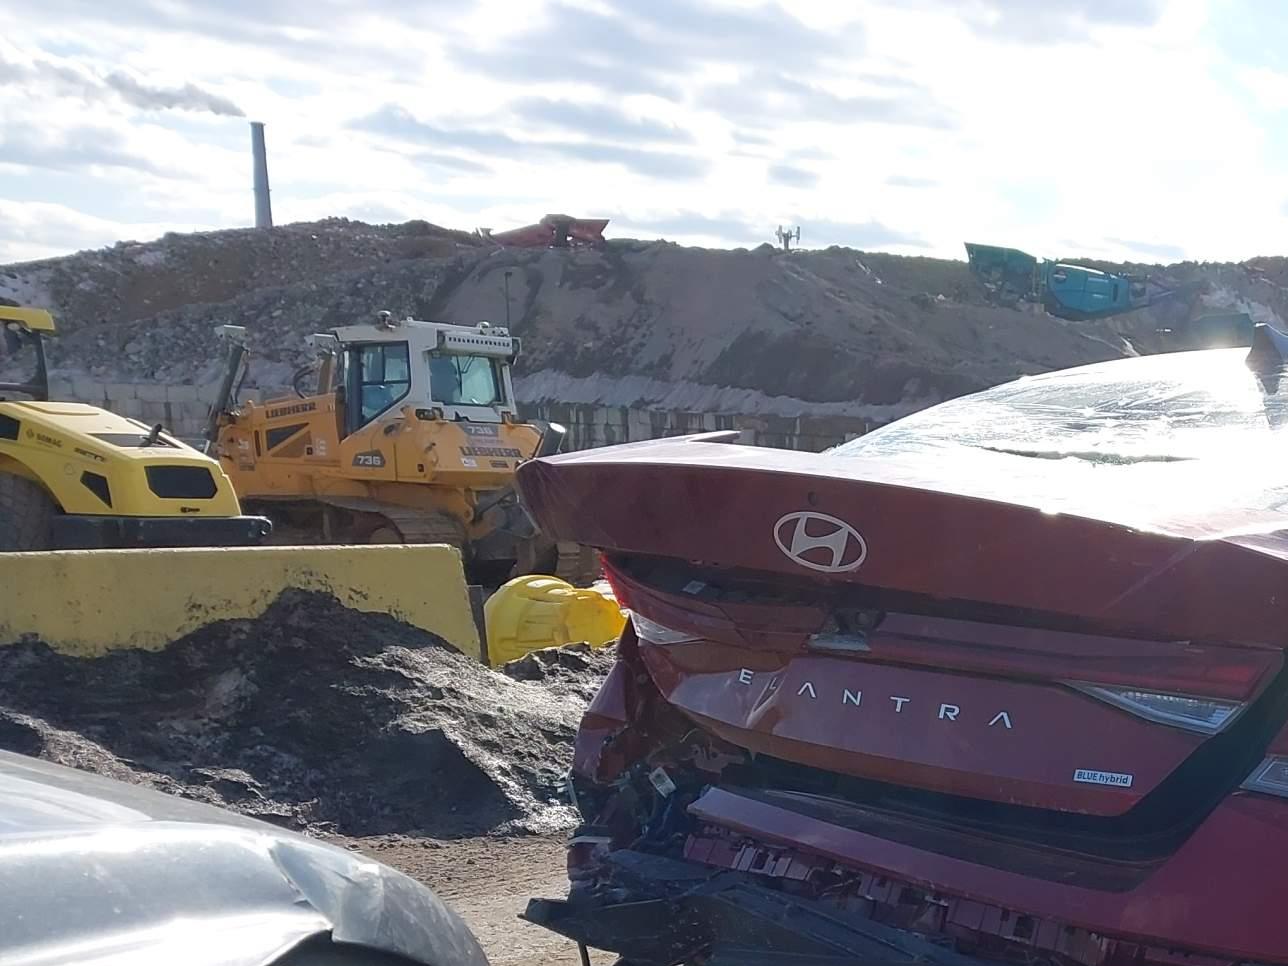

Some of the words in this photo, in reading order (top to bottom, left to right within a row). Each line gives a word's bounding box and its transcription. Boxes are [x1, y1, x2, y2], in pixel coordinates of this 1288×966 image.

[357, 455, 381, 465] 736
[739, 668, 1012, 729] ELANTRA
[1077, 771, 1098, 781] BLUE
[1099, 774, 1129, 784] hybrid
